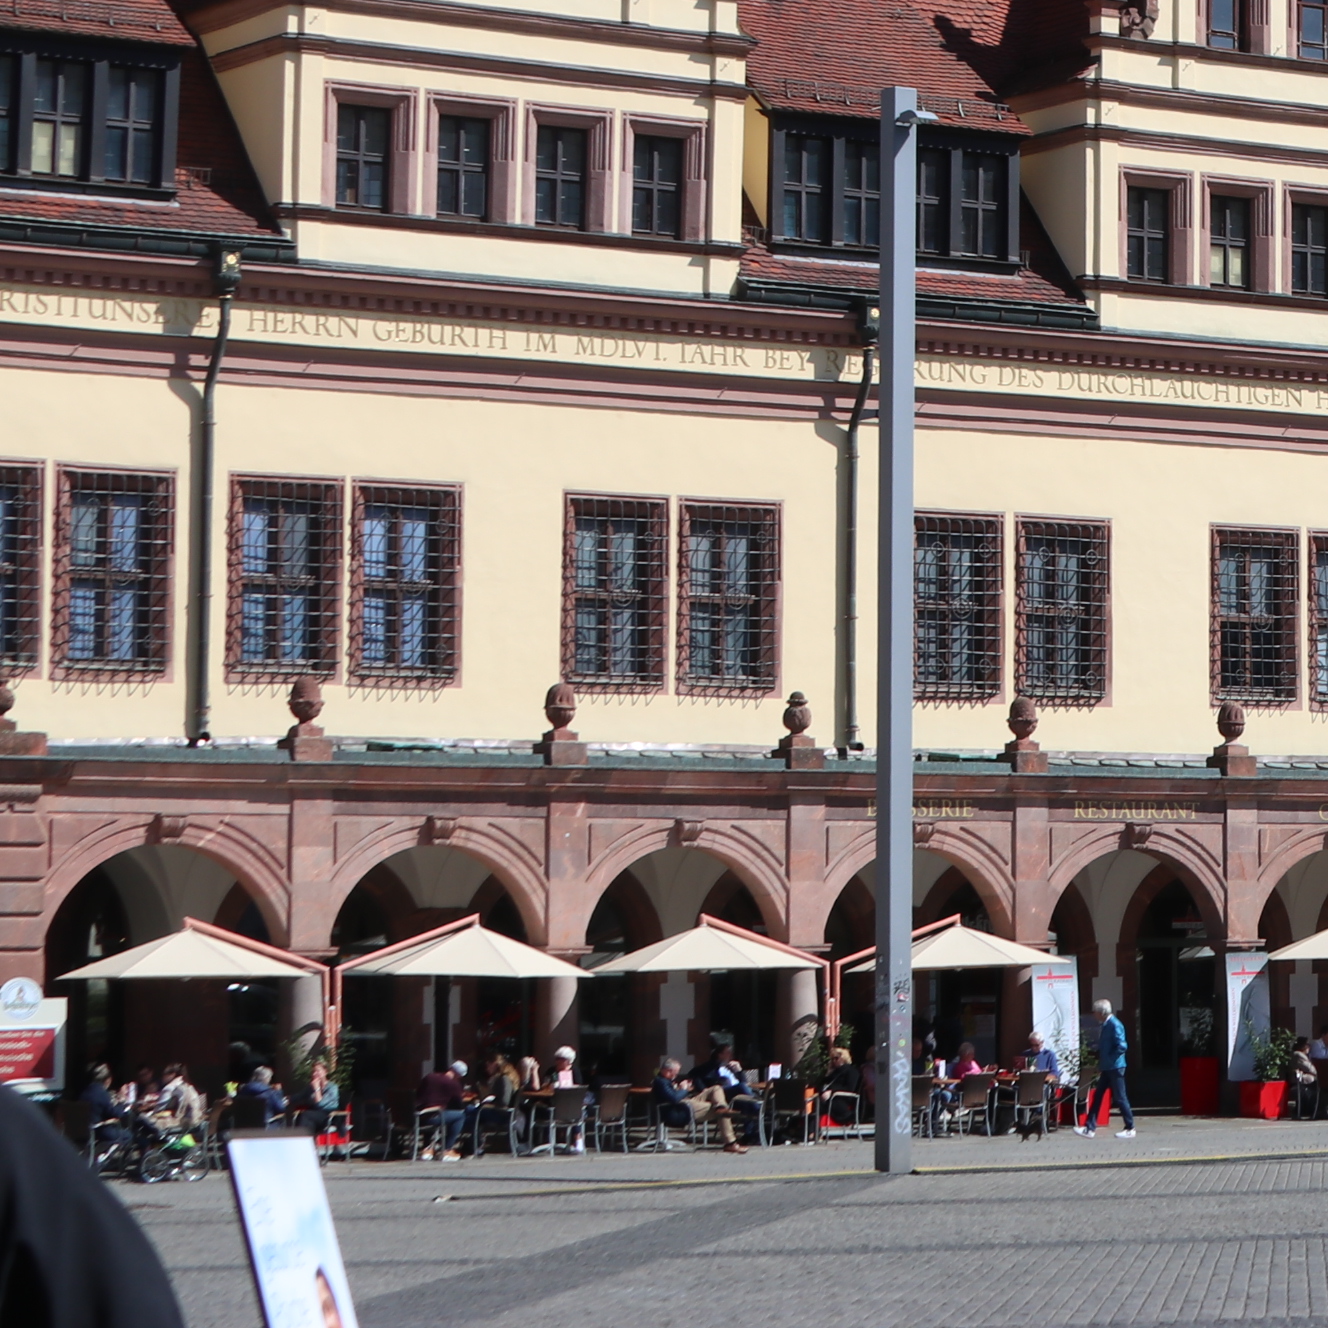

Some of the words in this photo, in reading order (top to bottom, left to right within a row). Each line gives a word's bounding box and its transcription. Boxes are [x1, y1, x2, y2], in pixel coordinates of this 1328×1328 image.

[87, 296, 221, 328] UNSERE
[246, 309, 360, 338] HERRN
[372, 318, 508, 350] GEBURTH
[524, 330, 557, 353] IM
[574, 334, 667, 362] MDLVI.
[680, 341, 751, 368] IAHR
[763, 348, 809, 372] BEY
[825, 349, 988, 385] REGRUNG
[998, 364, 1044, 388] DES
[1056, 369, 1303, 408] DURCHLAUCHTIGEN
[866, 799, 974, 818] BSSERIE
[1074, 800, 1200, 820] RESTAURANT
